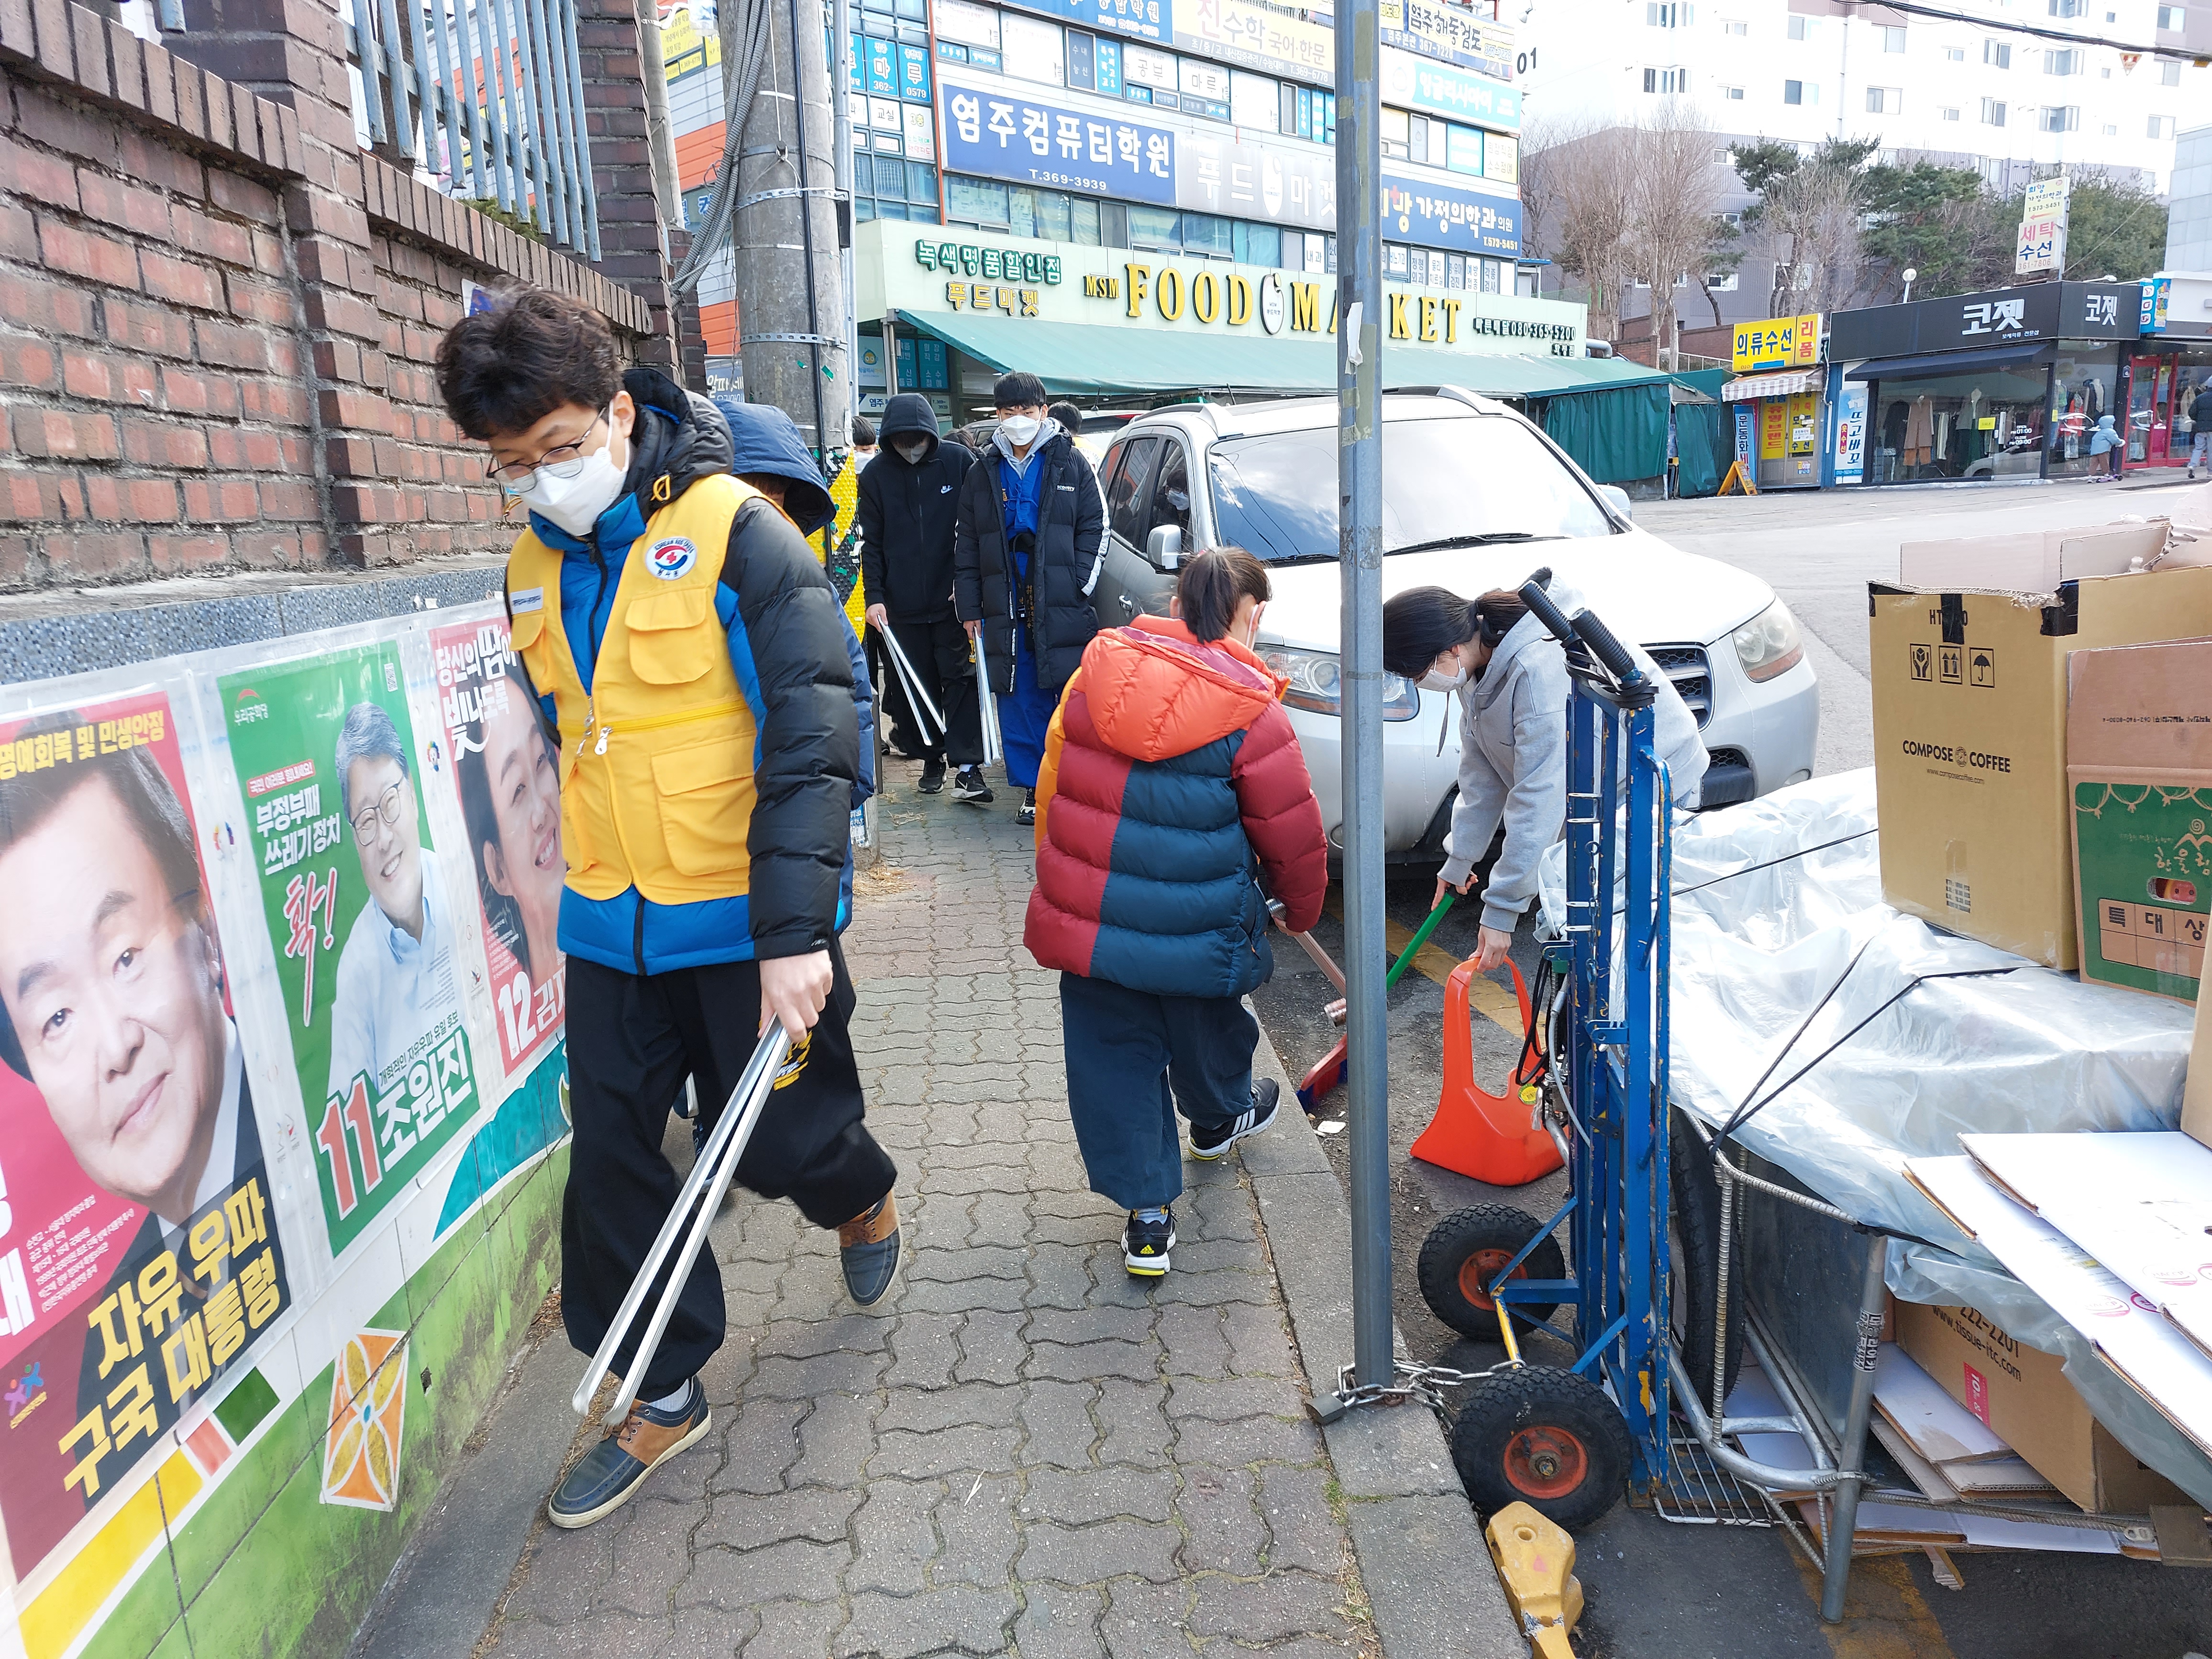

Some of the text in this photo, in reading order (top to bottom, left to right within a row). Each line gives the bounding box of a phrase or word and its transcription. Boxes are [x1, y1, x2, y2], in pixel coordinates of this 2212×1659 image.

[1419, 38, 1454, 60] 367-7228
[1289, 64, 1329, 83] T.369-6778
[906, 87, 927, 99] 0579
[877, 108, 894, 122] 교실
[910, 113, 924, 127] 3층
[951, 93, 1170, 179] 염주컴퓨터학원
[1029, 168, 1107, 191] T.369-3939
[1197, 155, 1255, 203] 푸드
[2027, 190, 2062, 203] 가정의학과
[2028, 201, 2060, 212] T.573-5451
[1415, 195, 1497, 239] 가정의학과
[1497, 217, 1514, 233] 의원
[2020, 221, 2056, 242] 세탁
[1306, 249, 1323, 264] 내과
[1482, 235, 1518, 251] T.573-5451
[2018, 240, 2053, 261] 수선
[916, 239, 1062, 285] 녹색명품할인점
[1411, 257, 1425, 271] 정형
[1412, 271, 1425, 285] 외과
[2017, 258, 2052, 271] 361-7806
[946, 281, 1040, 317] 푸드마켓
[1083, 263, 1461, 343] MSM FOOD MKET
[2084, 294, 2118, 327] 코젯
[1510, 320, 1577, 341] 080-365-5200
[1961, 298, 2025, 336] 코젯
[1736, 327, 1792, 357] 의류수선
[1799, 320, 1814, 359] 리폼
[1738, 414, 1748, 453] 운동화
[434, 639, 483, 687] 당신의
[233, 702, 269, 727] 우리공화당
[442, 679, 510, 762] 빛나도록
[76, 724, 96, 761] 및
[98, 709, 165, 755] 민생안정
[1902, 740, 2011, 774] COMPOSE COFFEE
[249, 777, 264, 794] 국민
[1926, 768, 1985, 785] www.composecoffee.com
[256, 783, 321, 838] 부정부패
[2109, 906, 2205, 941] 특 대 상
[497, 971, 538, 1062] 12
[378, 1050, 408, 1087] 개혁적인
[433, 1019, 448, 1041] 유일
[447, 1008, 459, 1028] 후보
[316, 1032, 473, 1222] 11 조원진
[88, 1248, 184, 1380] 자유
[188, 1176, 268, 1287] 우파
[57, 1361, 161, 1499] 구국
[161, 1256, 281, 1406] 대통령
